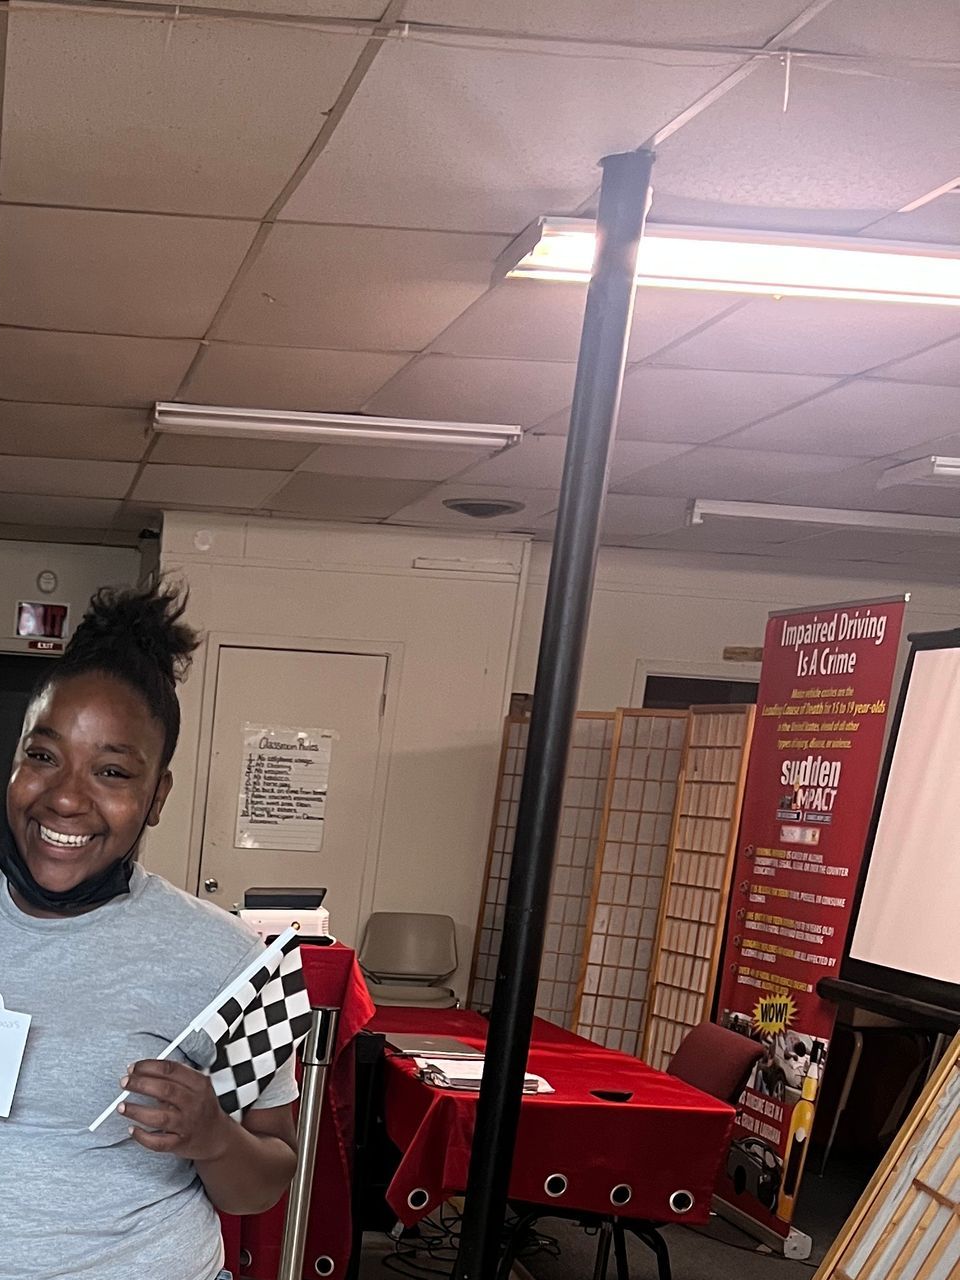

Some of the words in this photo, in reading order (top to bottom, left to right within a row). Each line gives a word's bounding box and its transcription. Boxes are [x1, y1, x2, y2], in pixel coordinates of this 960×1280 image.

[781, 613, 838, 652] Impaired
[838, 609, 888, 645] Driving
[37, 641, 54, 650] EXIT
[797, 650, 809, 677] Is
[808, 648, 819, 676] A
[820, 646, 857, 675] Crime
[831, 701, 840, 713] 15
[846, 701, 855, 713] 19
[853, 699, 886, 716] year-olds
[781, 755, 841, 787] sudden
[828, 957, 837, 967] BY
[760, 1002, 789, 1023] WOW!
